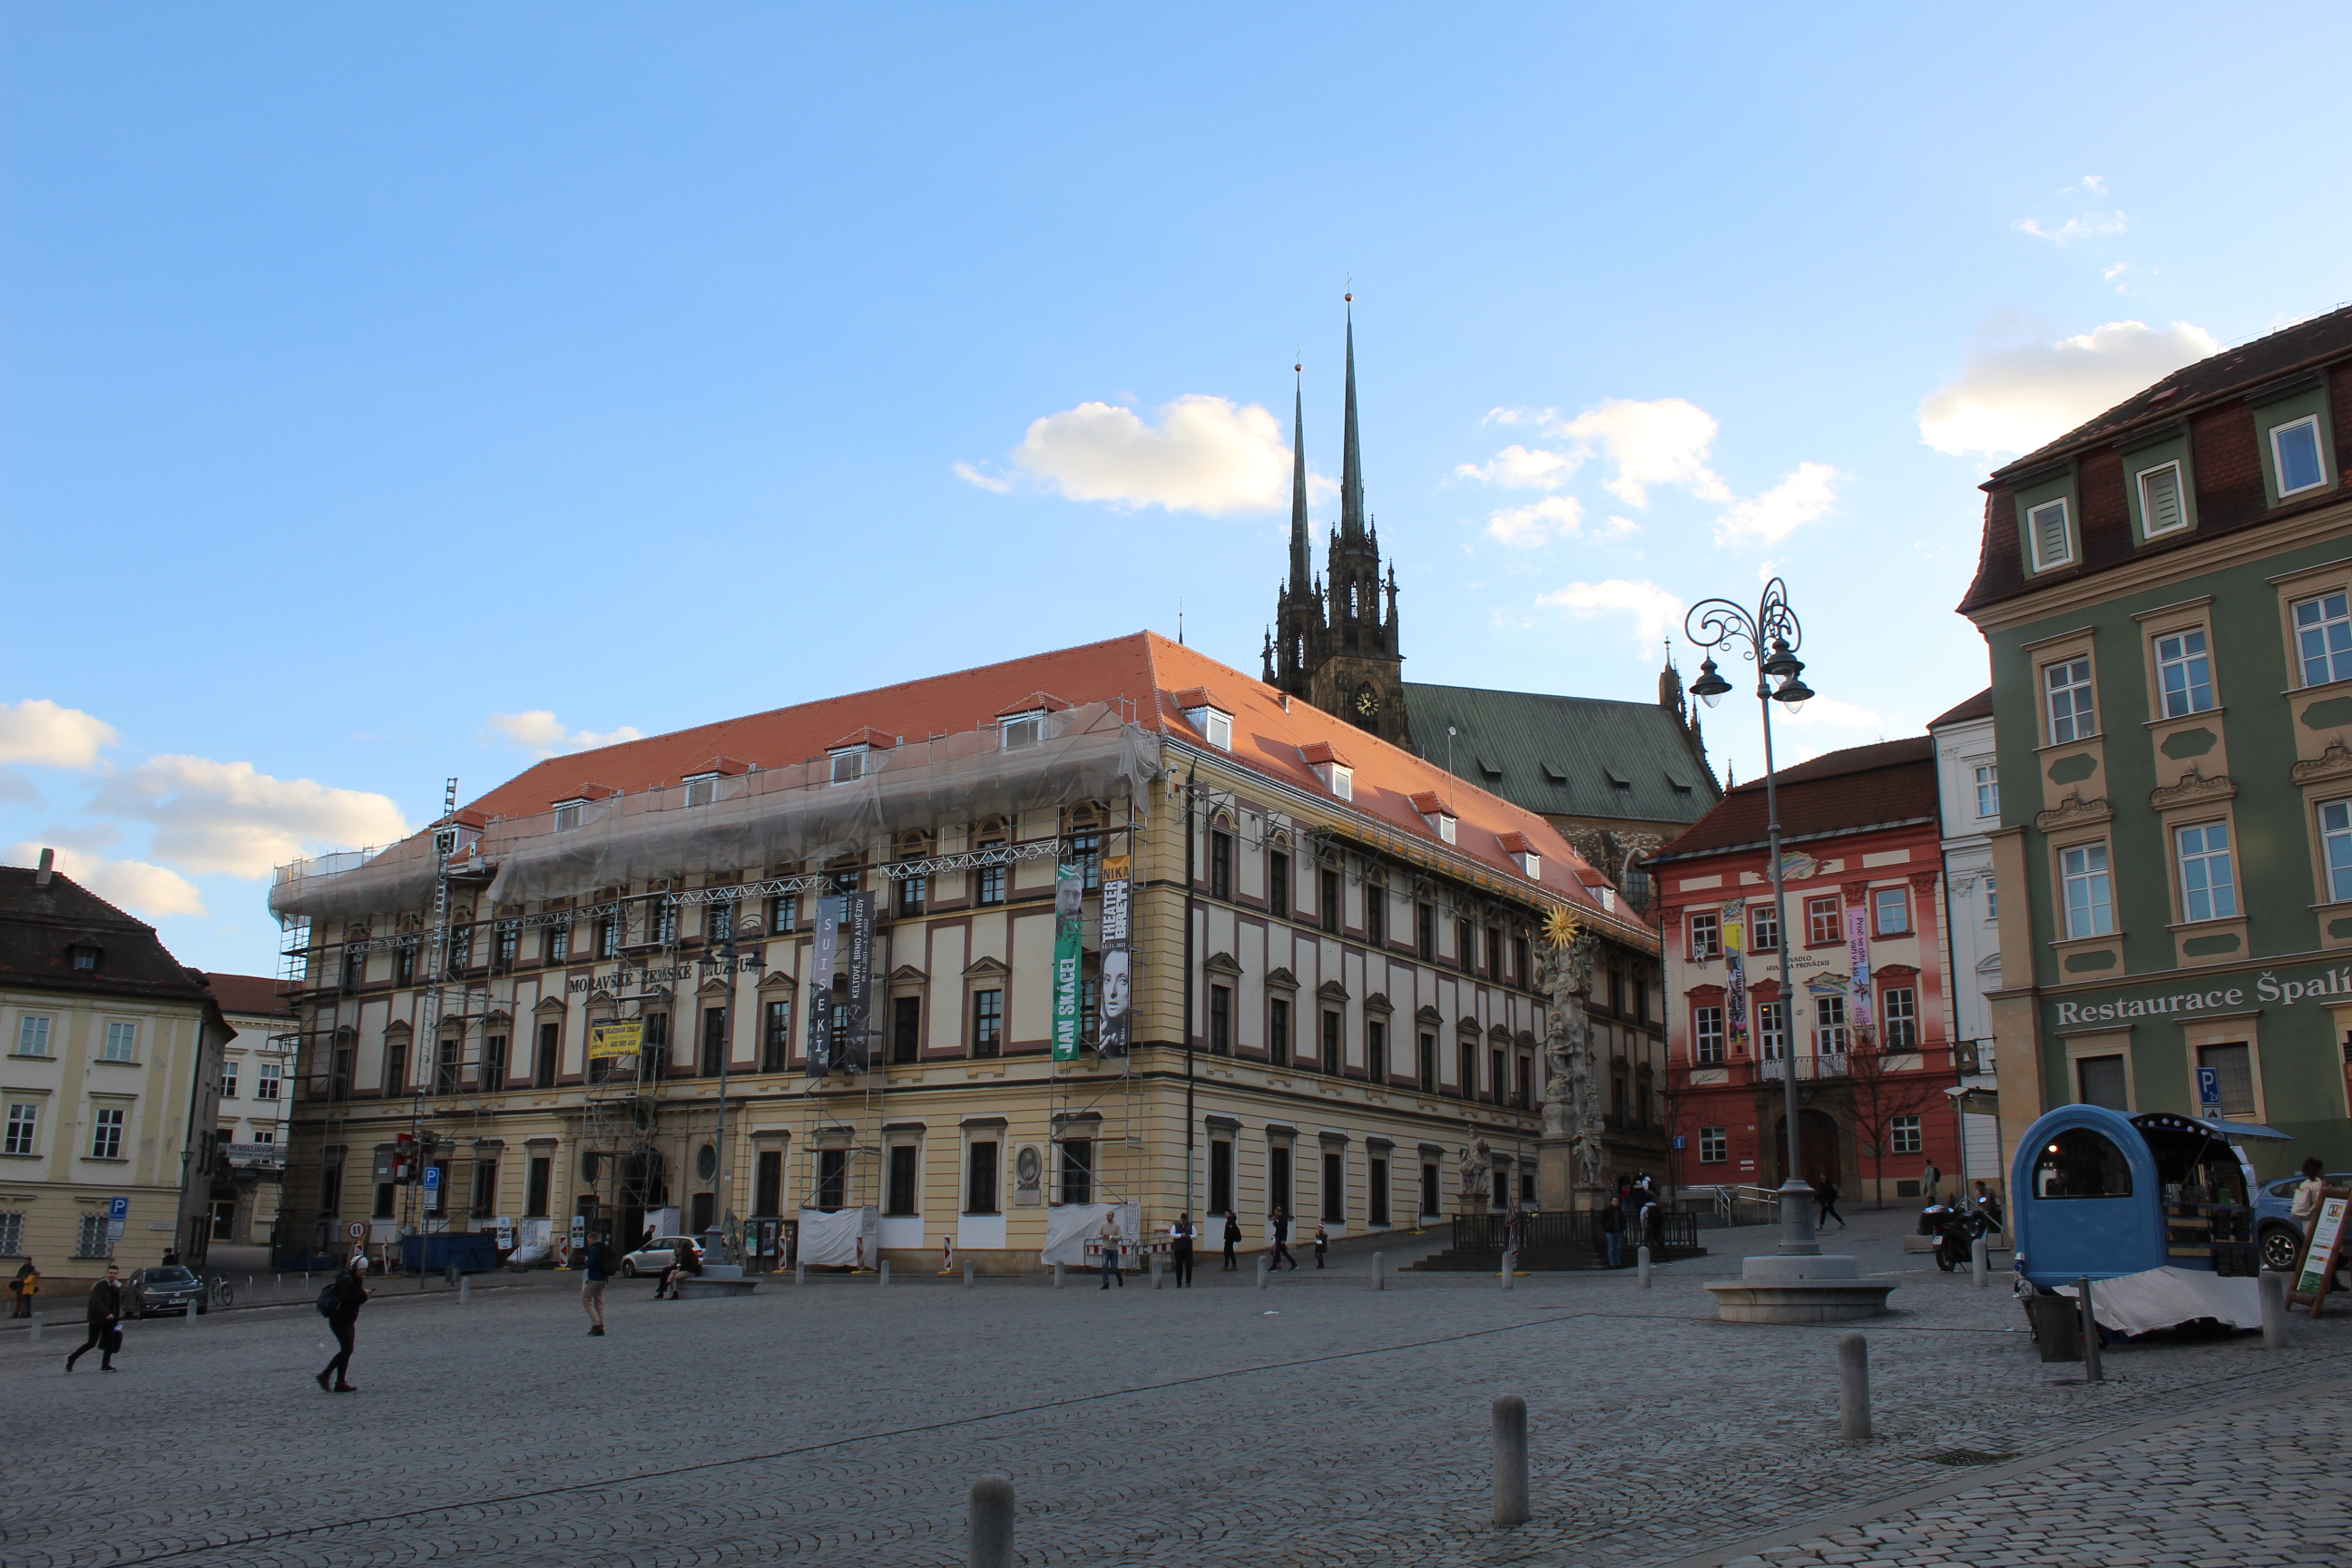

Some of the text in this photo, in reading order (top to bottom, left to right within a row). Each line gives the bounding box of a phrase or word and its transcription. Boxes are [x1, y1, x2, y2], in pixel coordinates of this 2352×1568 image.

[1103, 866, 1130, 880] NIKA
[854, 898, 864, 928] HVĚZDY
[1102, 881, 1117, 944] THEATER
[1115, 880, 1128, 939] BRETT
[853, 937, 862, 960] BRNO
[1850, 940, 1858, 954] vaří
[1856, 917, 1867, 963] Proč se dítě
[1788, 955, 1812, 963] IVADLO
[1796, 959, 1829, 969] PROVÁZKU
[641, 962, 691, 985] ZEMSKÉ
[701, 957, 760, 977] MUZEU
[815, 917, 832, 1053] SUISEKI
[1056, 954, 1076, 1054] JAN SKÁCEL
[2055, 967, 2352, 1026] Restaurace Špalí
[2201, 1071, 2214, 1093] P
[2209, 1092, 2220, 1101] 2x
[229, 1144, 274, 1153] MENDELIANUM
[426, 1170, 436, 1182] P
[113, 1200, 125, 1213] P
